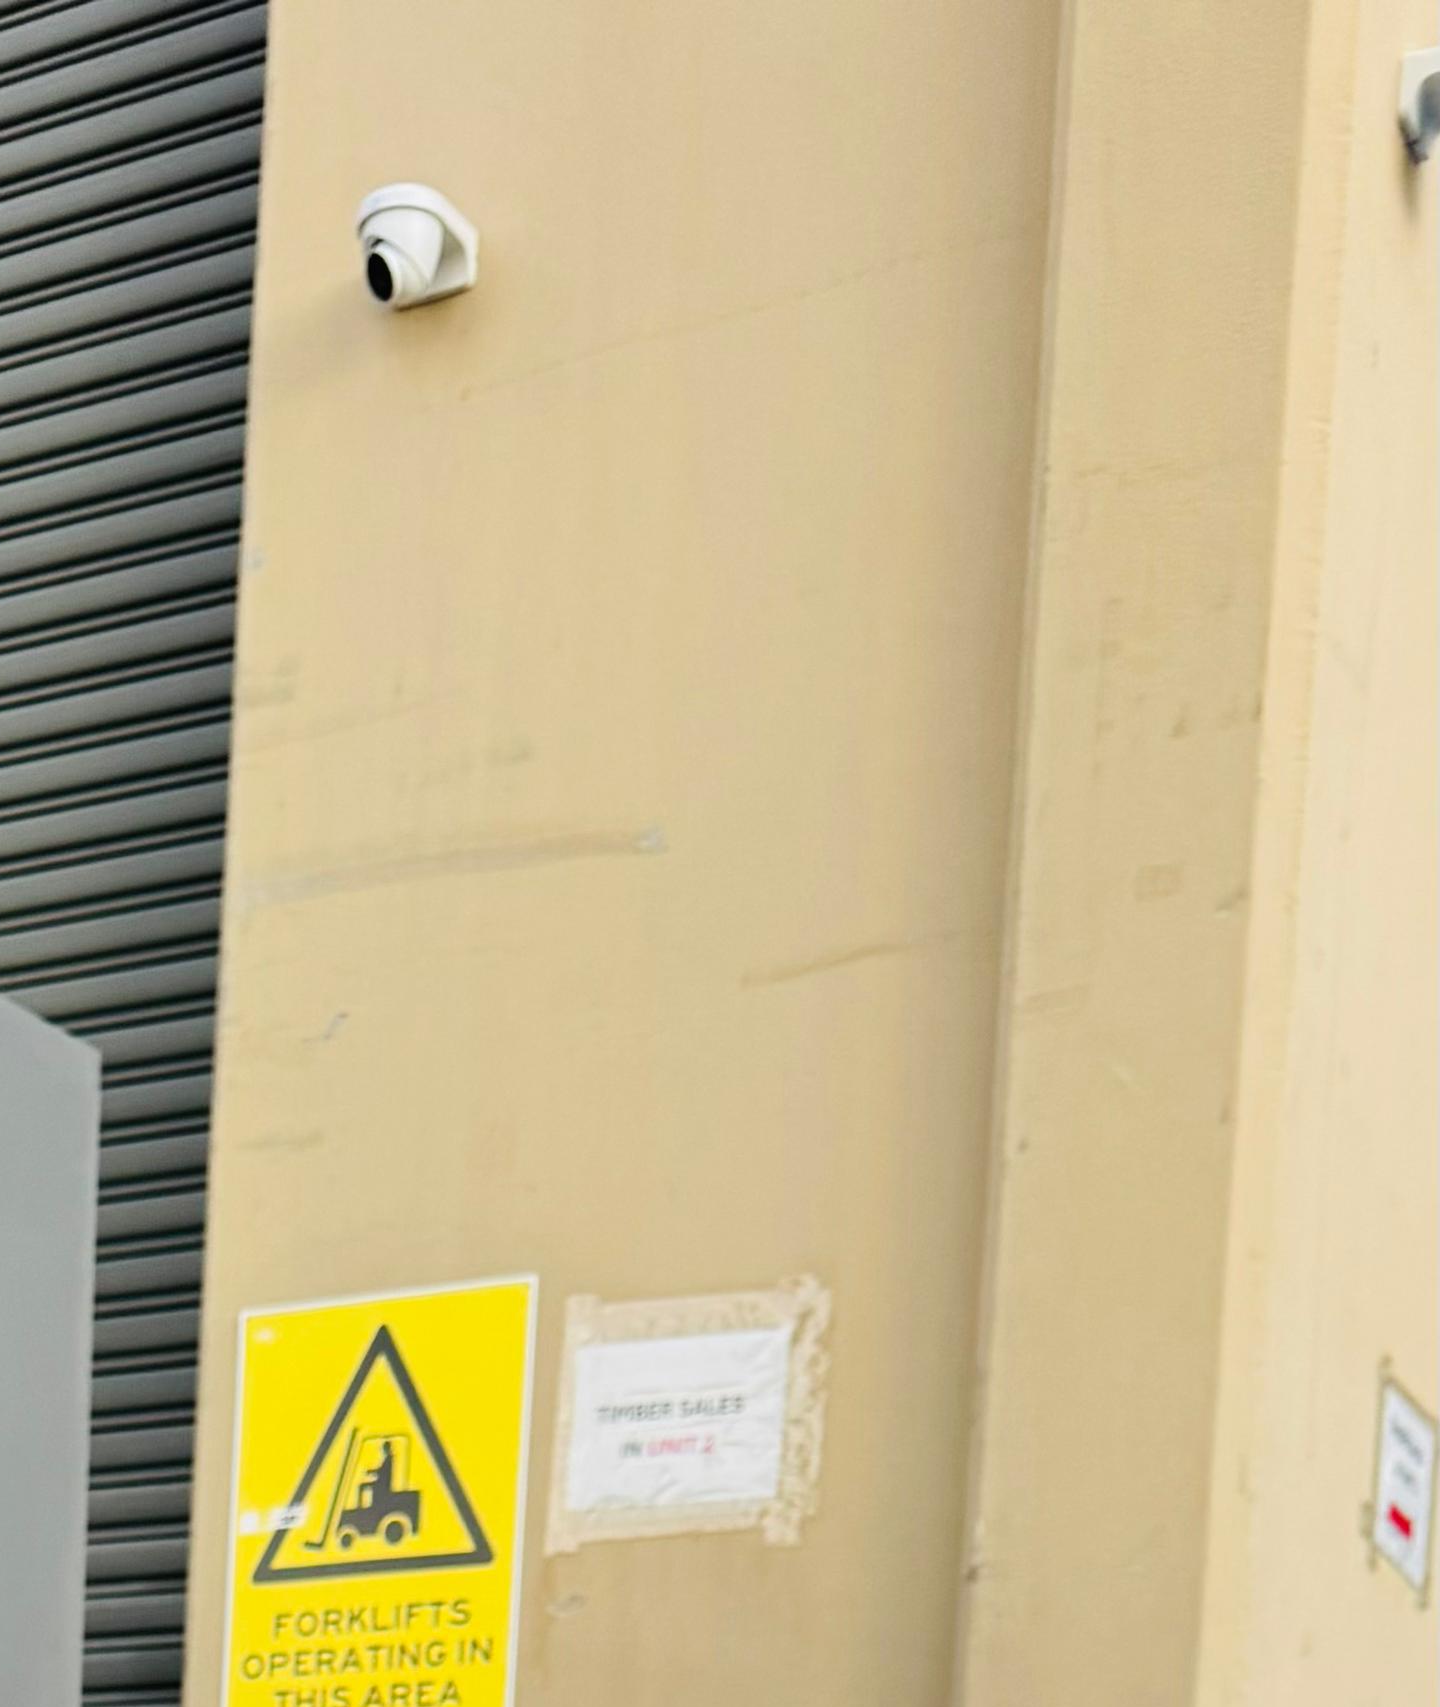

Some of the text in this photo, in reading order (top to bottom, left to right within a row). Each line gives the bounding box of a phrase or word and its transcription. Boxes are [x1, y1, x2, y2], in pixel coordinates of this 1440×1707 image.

[597, 1396, 746, 1423] TIMBER SALES
[273, 1600, 472, 1638] FORKLIFTS
[241, 1638, 494, 1680] OPERATING IN
